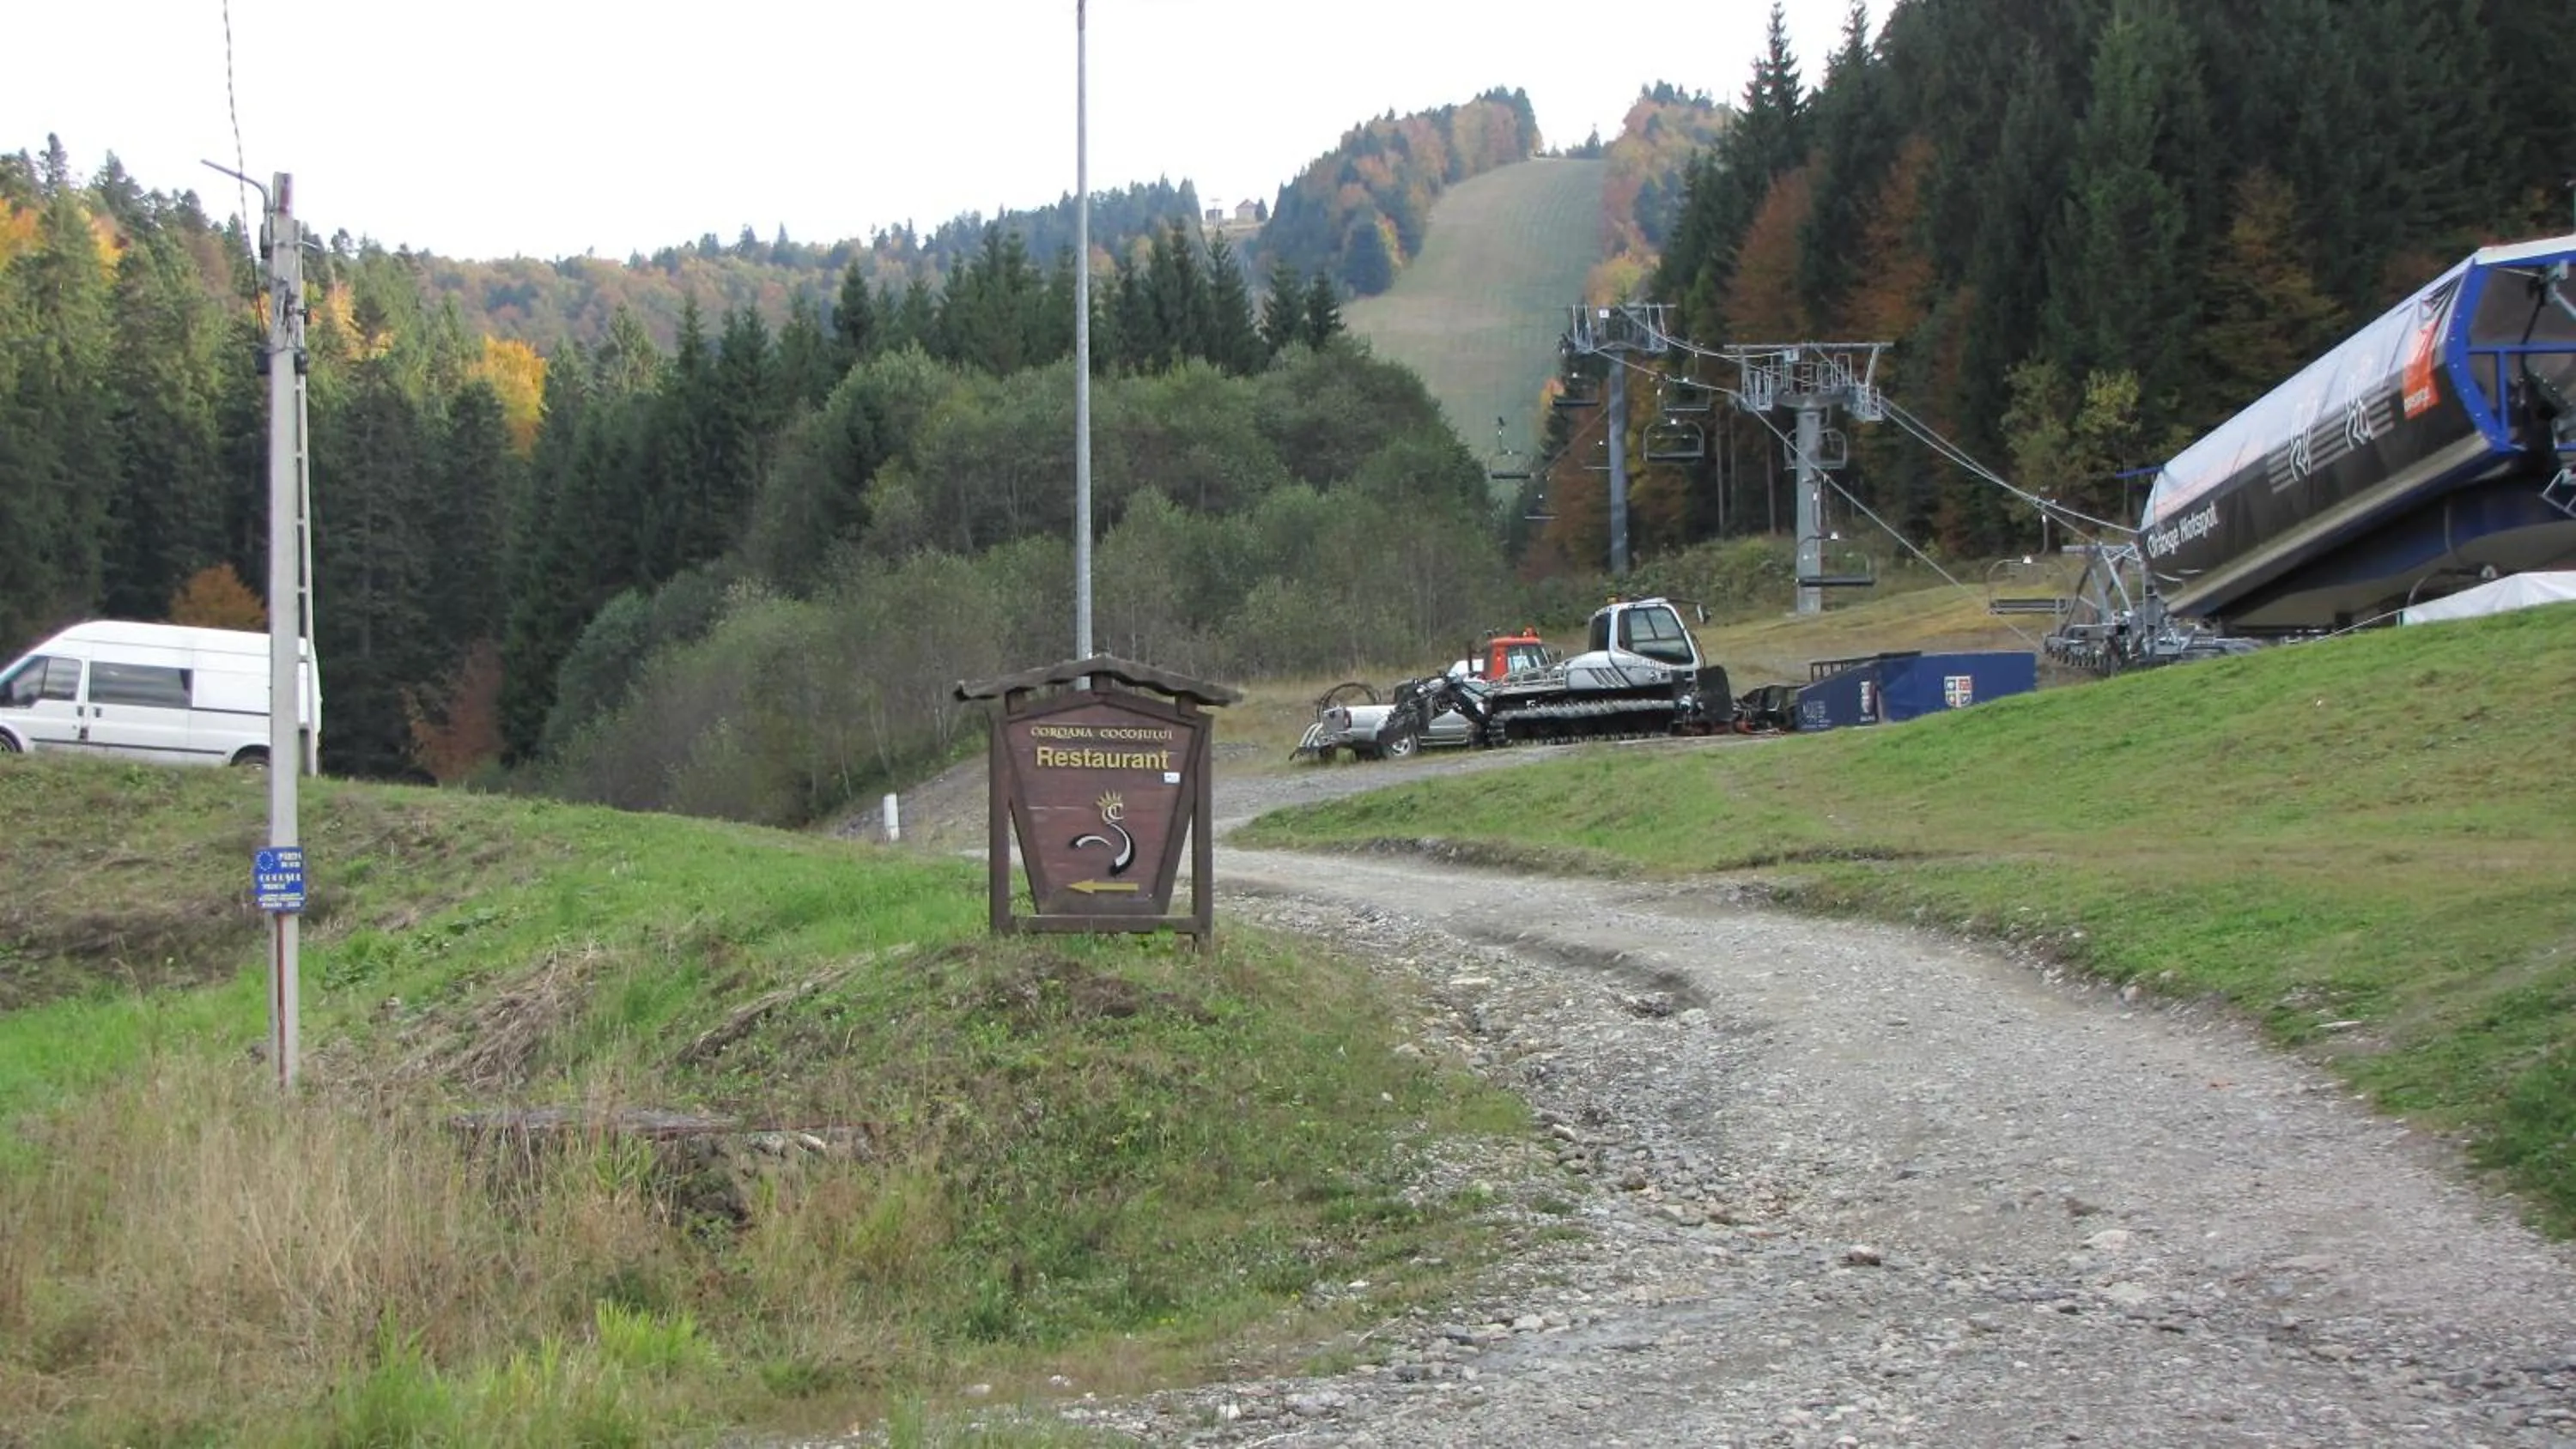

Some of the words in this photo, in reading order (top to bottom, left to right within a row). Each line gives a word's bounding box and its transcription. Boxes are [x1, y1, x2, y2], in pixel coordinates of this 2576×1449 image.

[2148, 528, 2179, 558] Orange
[2179, 500, 2218, 543] Hotspot
[1036, 746, 1169, 769] Restaurant
